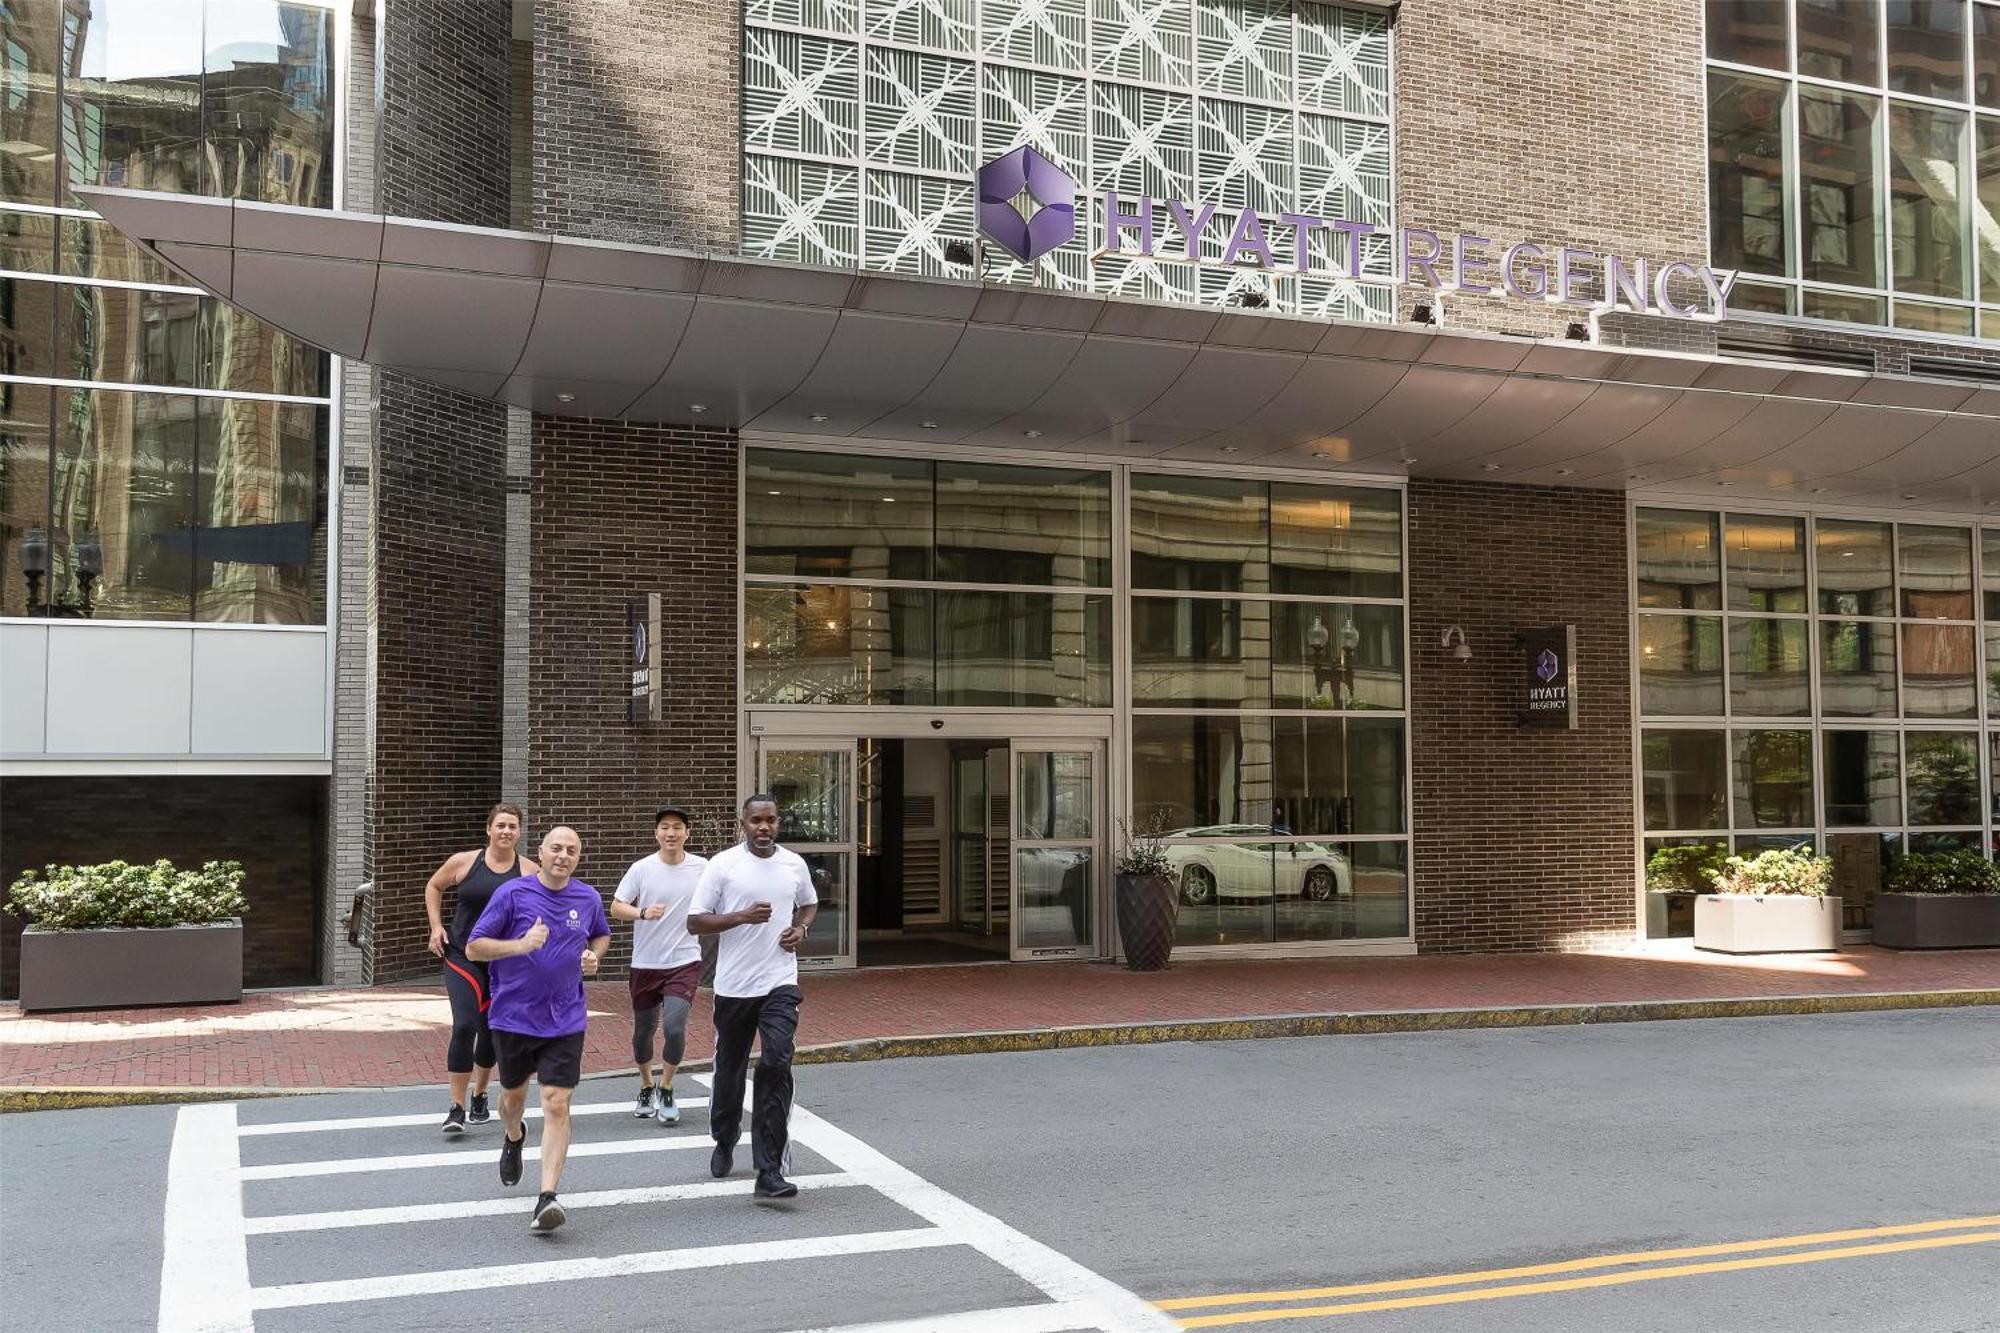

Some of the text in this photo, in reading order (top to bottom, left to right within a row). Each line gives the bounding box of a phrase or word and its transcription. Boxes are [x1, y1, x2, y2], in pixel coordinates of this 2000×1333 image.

[1107, 192, 1738, 320] HYATT REGENCY
[1530, 686, 1566, 699] HYATT
[1530, 700, 1566, 710] REGENCY
